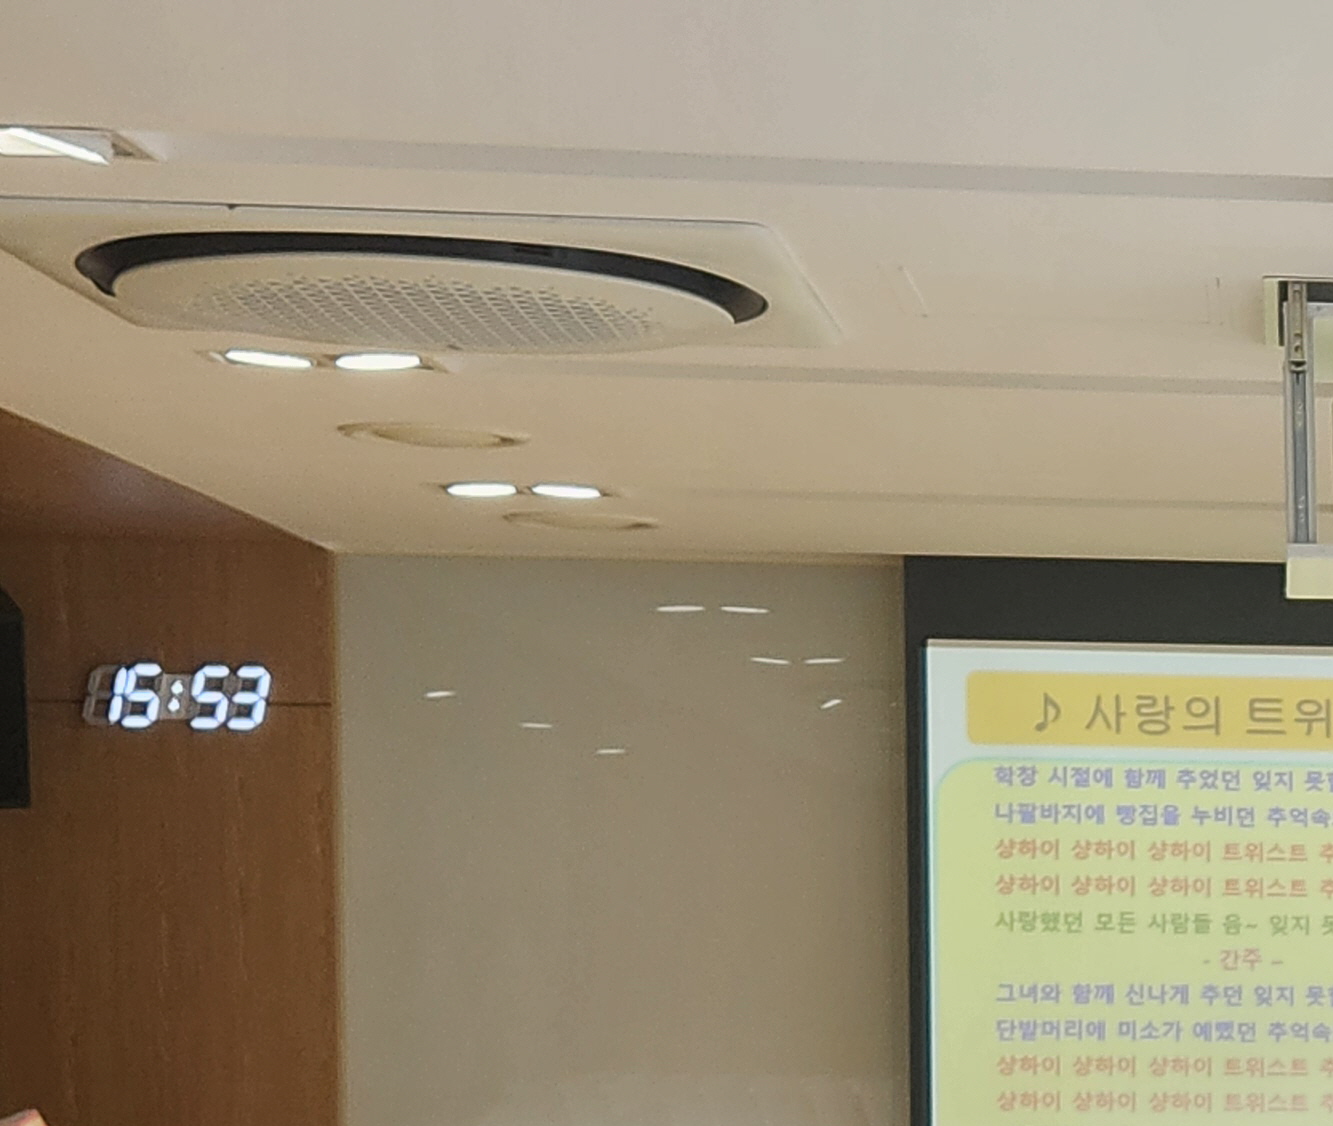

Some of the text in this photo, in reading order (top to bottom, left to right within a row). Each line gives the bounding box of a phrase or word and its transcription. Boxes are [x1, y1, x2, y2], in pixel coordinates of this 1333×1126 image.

[108, 663, 271, 731] 15:53
[1085, 694, 1222, 735] 사랑의
[994, 765, 1038, 787] 학창
[1048, 766, 1113, 788] 시절에
[1125, 767, 1166, 789] 함께
[1176, 768, 1240, 791] 추었던
[1253, 770, 1294, 791] 잊지
[995, 803, 1105, 825] 나팔바지에
[1116, 804, 1180, 826] 빵집을
[1191, 805, 1255, 828] 누비던
[1222, 841, 1308, 862] 트위스트
[1222, 877, 1308, 898] 트위스트
[995, 911, 1083, 933] 사랑했던
[1095, 912, 1136, 934] 모든
[1148, 913, 1212, 935] 사람들
[1270, 914, 1310, 935] 잊지
[1220, 948, 1262, 971] 간주
[996, 984, 1061, 1005] 그녀와
[1073, 983, 1114, 1005] 함께
[1126, 984, 1190, 1006] 신나게
[1201, 985, 1243, 1006] 추던
[1254, 985, 1295, 1007] 잊지
[995, 1020, 1106, 1042] 단발머리에
[1117, 1020, 1183, 1042] 미소가
[1224, 1057, 1309, 1077] 트위스트
[1224, 1092, 1309, 1113] 트위스트
